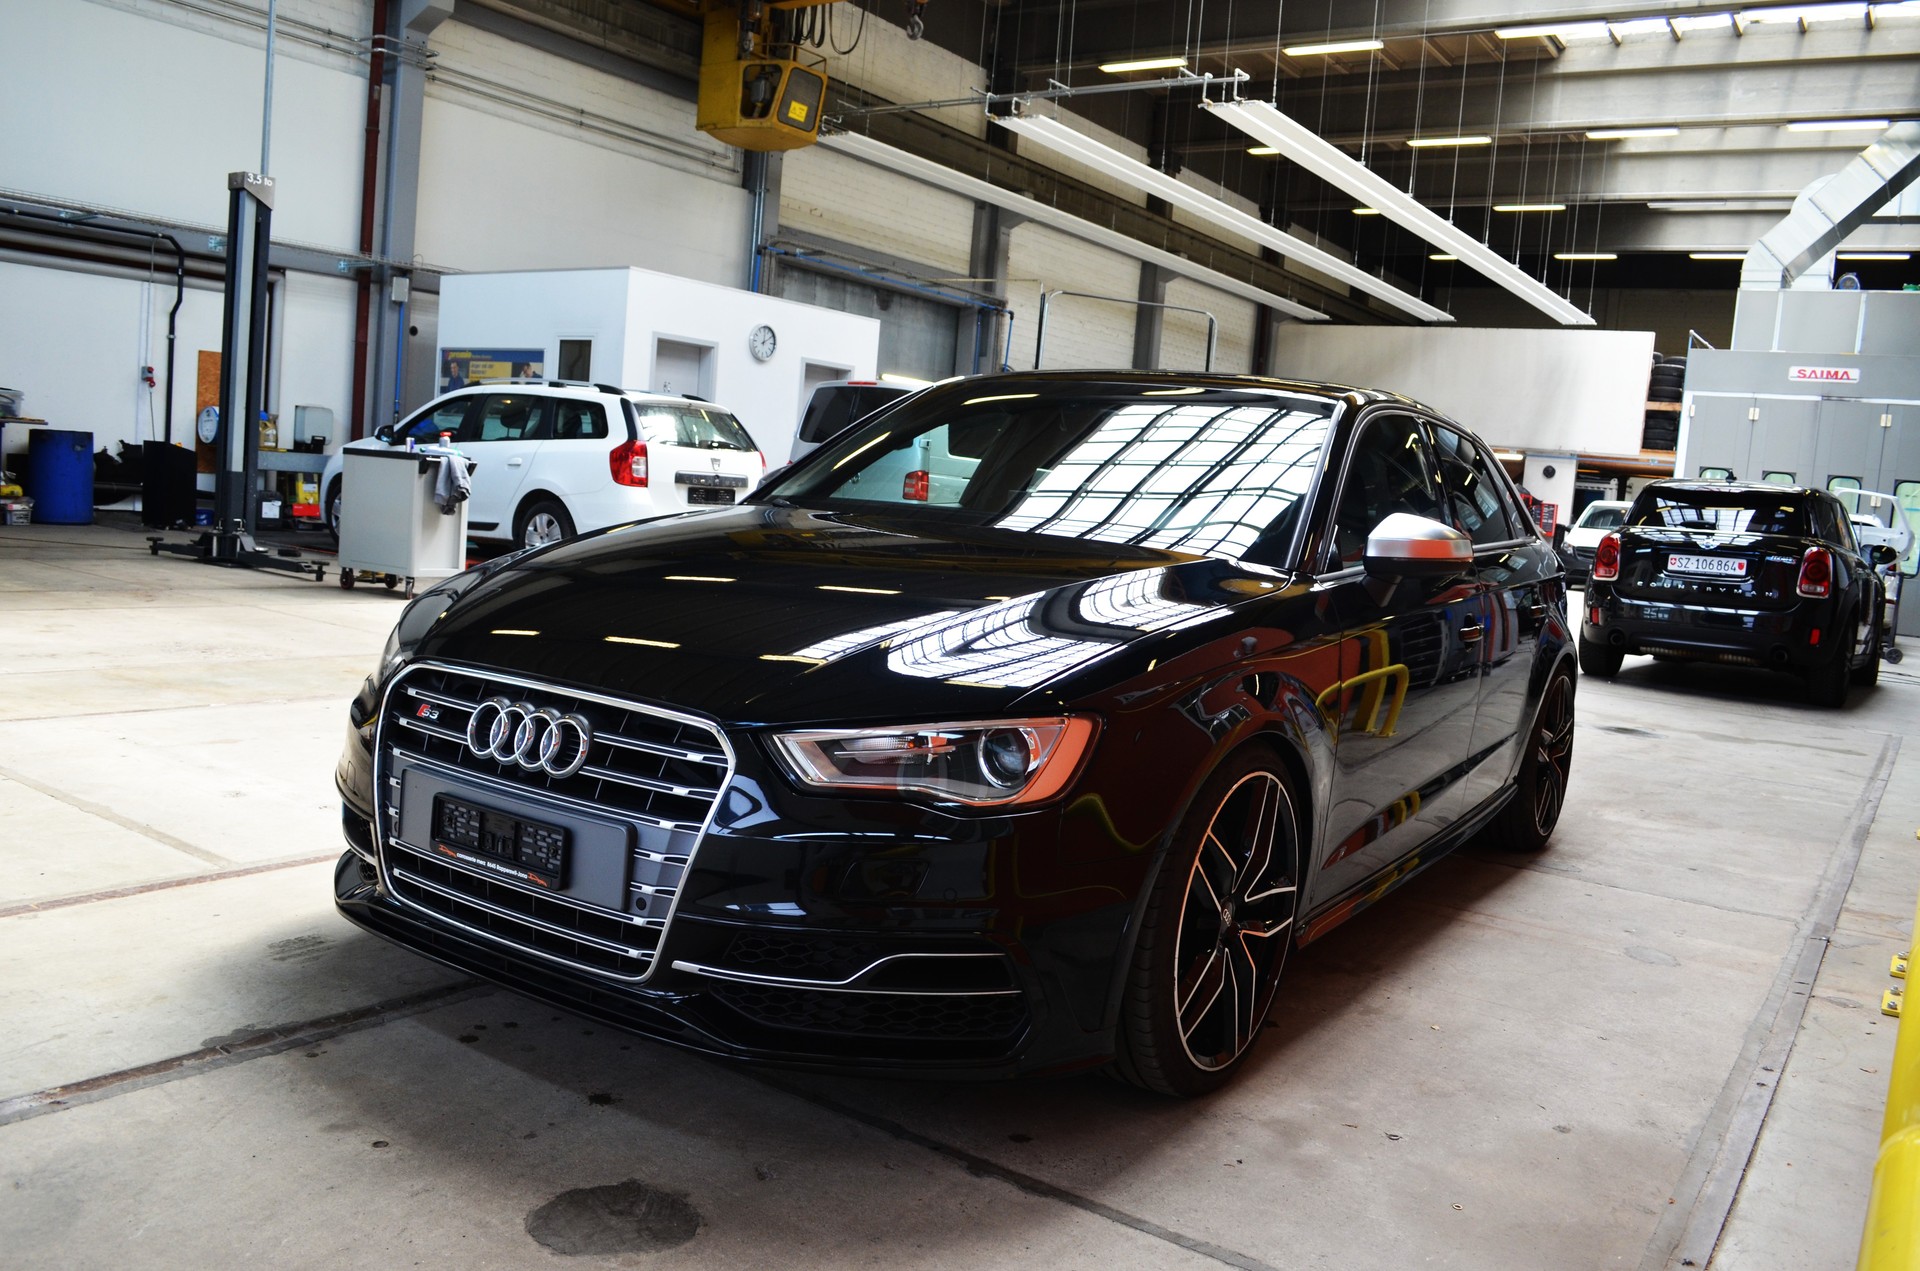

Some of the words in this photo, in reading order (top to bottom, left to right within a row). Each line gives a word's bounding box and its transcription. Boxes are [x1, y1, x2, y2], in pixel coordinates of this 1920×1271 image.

[247, 173, 262, 185] 3,5
[264, 177, 273, 187] to
[1797, 369, 1851, 381] SAIMA
[1636, 581, 1775, 598] COUNTRYMAN
[420, 706, 440, 720] S3
